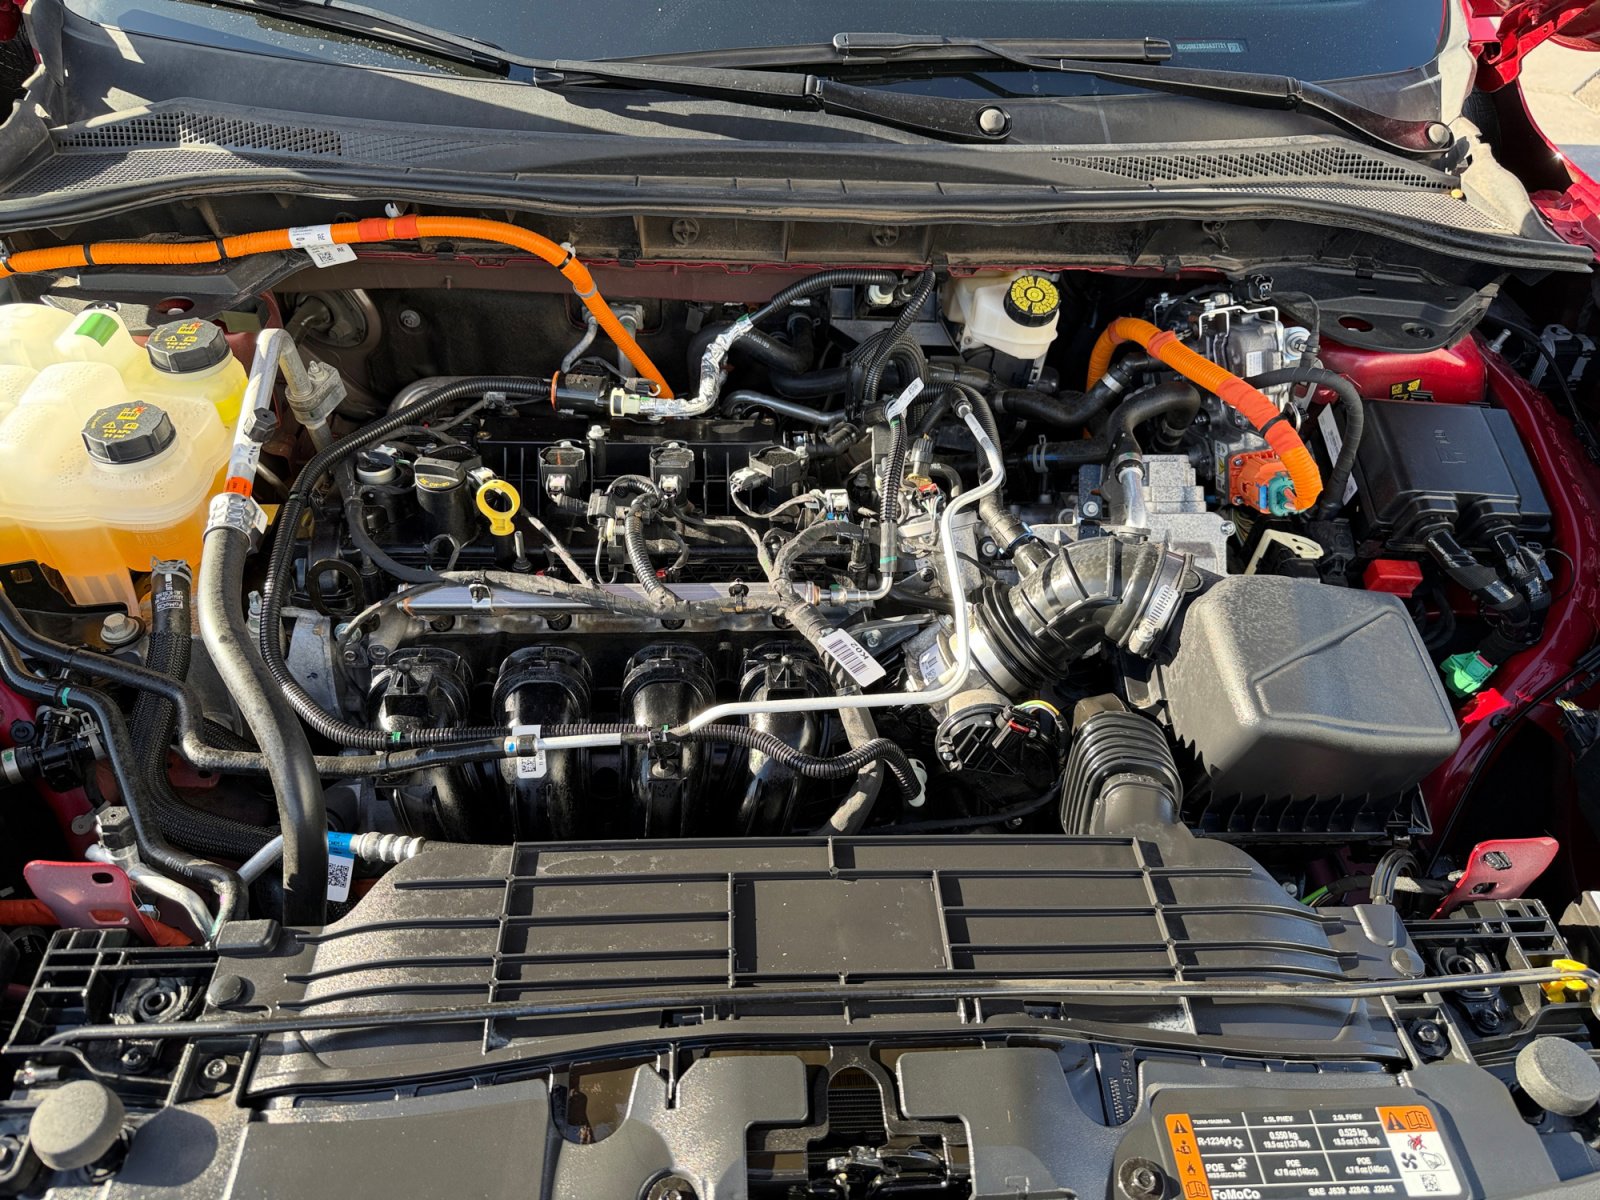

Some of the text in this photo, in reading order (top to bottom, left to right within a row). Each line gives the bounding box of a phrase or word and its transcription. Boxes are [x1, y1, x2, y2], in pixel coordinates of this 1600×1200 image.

[850, 643, 869, 660] K02
[1269, 1131, 1299, 1141] 0.550 kg
[1338, 1127, 1368, 1138] 0.525 kg
[1197, 1136, 1232, 1147] R-1234yf
[1286, 1159, 1301, 1167] POE
[1356, 1156, 1372, 1165] POE
[1205, 1163, 1225, 1172] POE
[1274, 1168, 1283, 1176] 4.7
[1345, 1166, 1354, 1174] 4.7
[1211, 1188, 1261, 1200] FoMoCo
[1308, 1185, 1395, 1196] SAE J639 J2842 J2845
